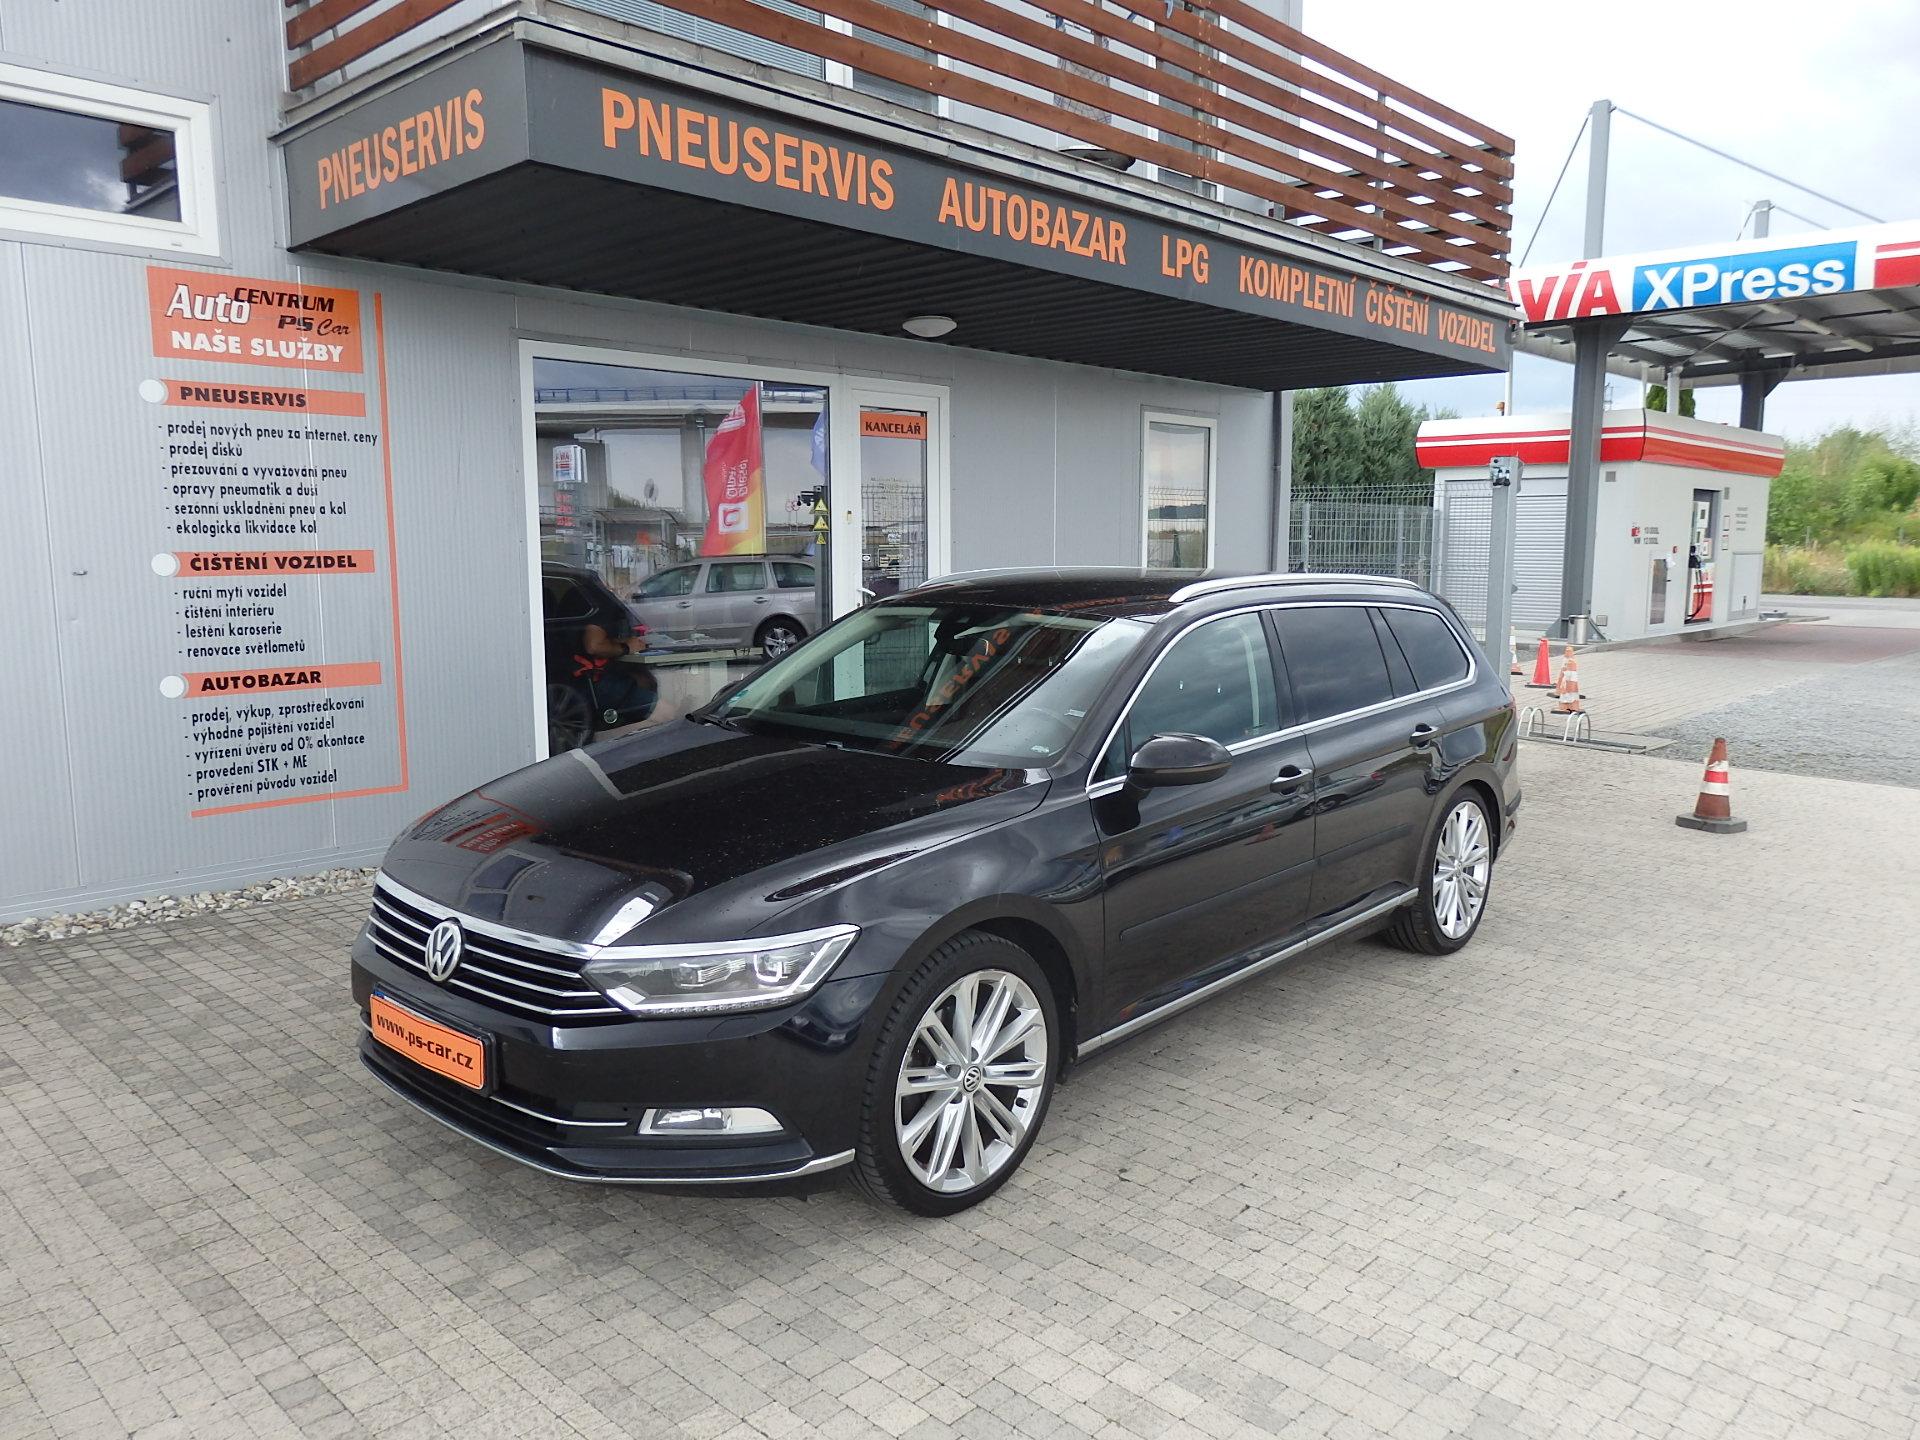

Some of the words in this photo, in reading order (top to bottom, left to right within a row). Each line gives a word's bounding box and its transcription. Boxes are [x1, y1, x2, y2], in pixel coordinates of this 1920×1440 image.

[318, 88, 485, 210] PNEUSERVIS
[602, 87, 895, 211] PNEUSERVIS
[938, 177, 1127, 266] AUTOBAZAR
[1162, 235, 1209, 284] LPG
[1239, 255, 1356, 318] KOMPLETNÍ
[1365, 281, 1429, 336] ČIŠTĚNÍ
[1437, 308, 1496, 353] VOZIDEL
[1643, 258, 1846, 311] XPress
[165, 282, 252, 325] Auto
[233, 287, 335, 313] CENTRUM
[278, 314, 315, 332] PS
[316, 318, 352, 336] Car
[171, 329, 242, 355] NAŠE
[250, 336, 344, 363] SLUŽBY
[180, 386, 308, 408] PNEUSERVIS
[167, 420, 207, 439] prodej
[210, 422, 252, 440] nových
[256, 428, 284, 441] pneu
[288, 429, 301, 440] za
[305, 426, 350, 442] internet.
[353, 433, 378, 447] ceny
[865, 421, 921, 435] KANCELÁŘ
[169, 441, 208, 459] prodej
[171, 461, 238, 478] přezouvání
[242, 466, 249, 476] a
[253, 464, 318, 480] vyvažování
[321, 468, 347, 481] pneu
[172, 484, 215, 499] opravy
[220, 482, 282, 499] pneumatik
[285, 486, 293, 496] a
[174, 501, 219, 515] sezónní
[223, 500, 286, 515] uskladnění
[289, 504, 316, 518] pneu
[319, 505, 326, 515] a
[329, 501, 347, 515] kol
[176, 519, 241, 538] ekologická
[245, 519, 296, 534] likvidace
[299, 519, 317, 534] kol
[190, 552, 268, 571] ČIŠTĚNÍ
[274, 554, 357, 570] VOZIDEL
[183, 586, 212, 600] ruční
[216, 585, 243, 602] mytí
[247, 582, 287, 598] vozidel
[184, 604, 222, 619] čištění
[225, 602, 275, 618] interiéru
[185, 623, 225, 638] leštění
[228, 621, 282, 637] karoserie
[187, 645, 241, 658] renovace
[245, 639, 306, 655] světlometů
[201, 670, 323, 692] AUTOBAZAR
[191, 701, 232, 727] prodej,
[236, 699, 274, 722] výkup,
[278, 696, 365, 718] zprostředkování
[193, 725, 244, 746] výhodné
[247, 721, 294, 741] pojištění
[297, 715, 335, 732] vozidel
[194, 743, 242, 764] vyřízení
[246, 742, 277, 756] úvěru
[280, 737, 294, 751] od
[297, 736, 313, 750] 0%
[317, 734, 365, 748] akontace
[196, 761, 254, 784] provedení
[257, 757, 280, 773] STK
[293, 754, 308, 769] ME
[198, 779, 253, 803] prověření
[257, 774, 297, 795] původu
[300, 768, 338, 786] vozidel
[376, 1014, 474, 1070] www.ps-car.cz
